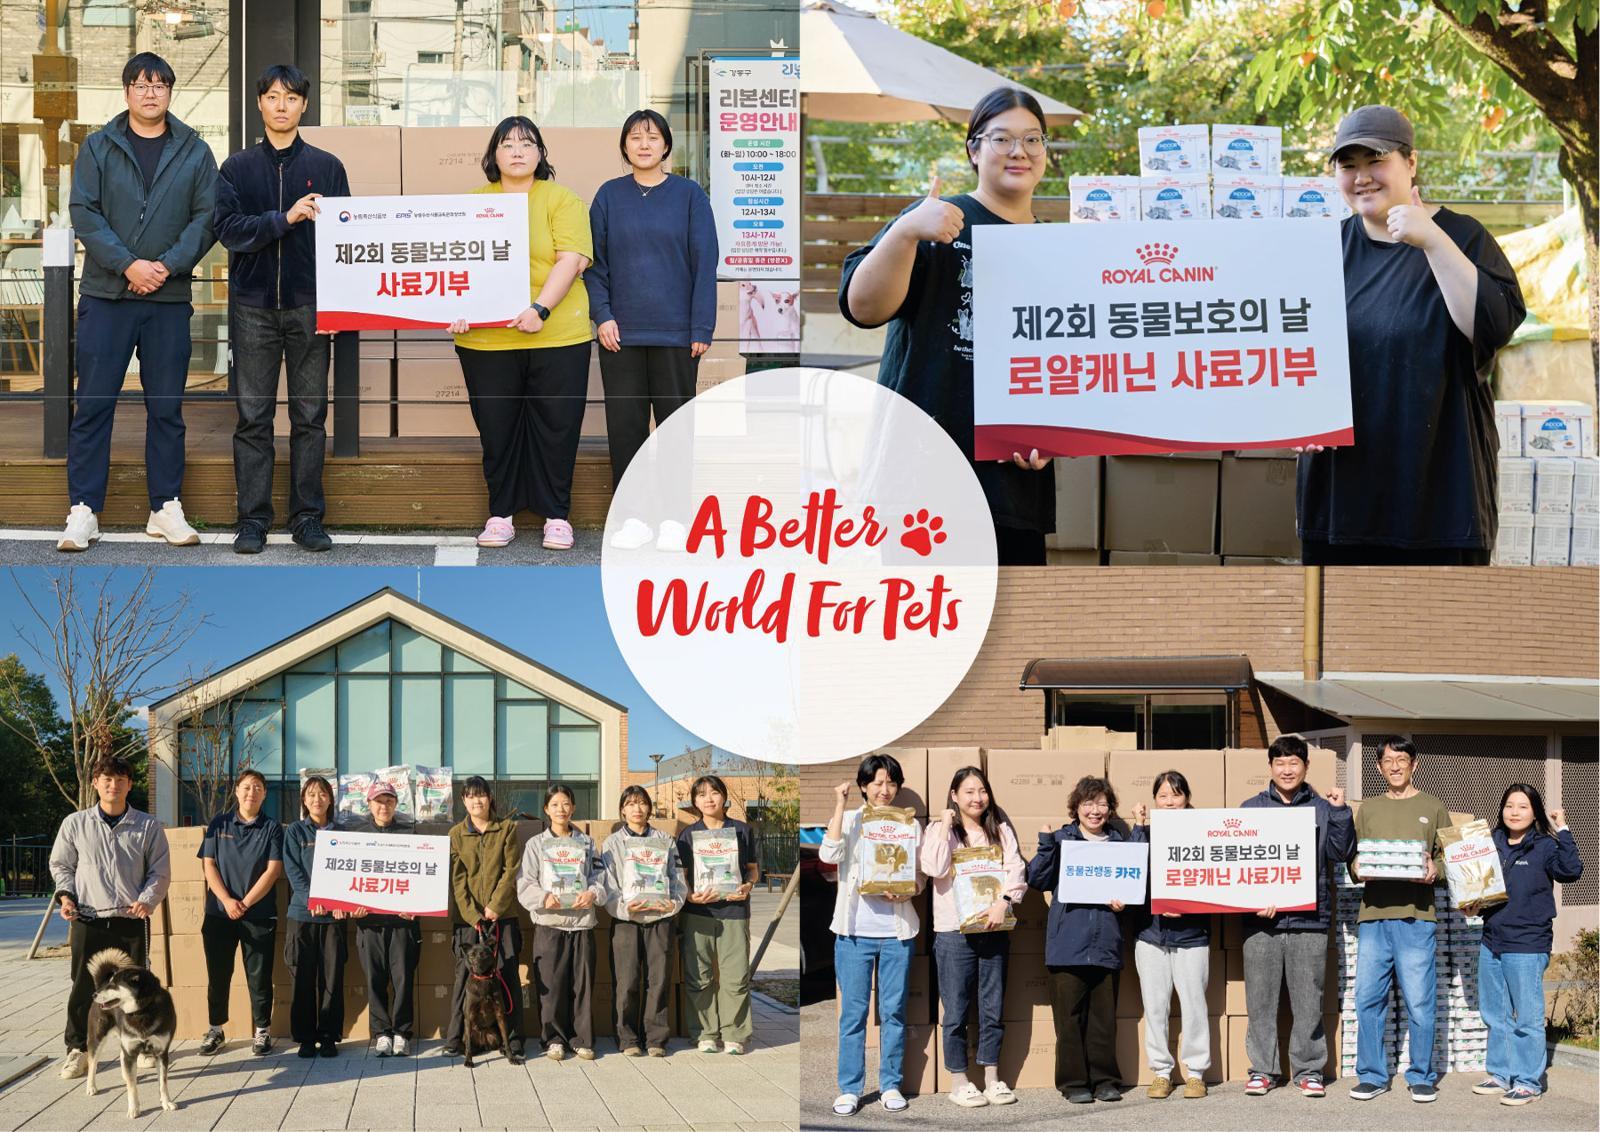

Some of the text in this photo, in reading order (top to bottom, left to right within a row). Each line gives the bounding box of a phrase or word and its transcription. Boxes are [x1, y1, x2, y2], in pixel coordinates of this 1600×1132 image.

[720, 88, 797, 108] 리본센터
[720, 112, 797, 132] 운영안내
[746, 150, 768, 159] 10:00
[775, 150, 797, 159] 18:00
[335, 239, 512, 265] 제2회 동물보호의 날
[376, 270, 470, 298] 사료기부
[1102, 265, 1214, 285] ROYAL CANIN
[1011, 297, 1311, 341] 제2회 동물보호의 날
[1008, 346, 1318, 396] 로얄캐닌 사료기부
[1207, 829, 1258, 838] ROYAL CANIN
[1167, 844, 1301, 863] 제2회 동물보호의 날
[325, 857, 438, 876] 제2회 동물보호의 날
[1065, 865, 1113, 878] 동물권행동
[1165, 866, 1302, 887] 로얄캐닌 사료기부
[348, 876, 410, 895] 사료기부
